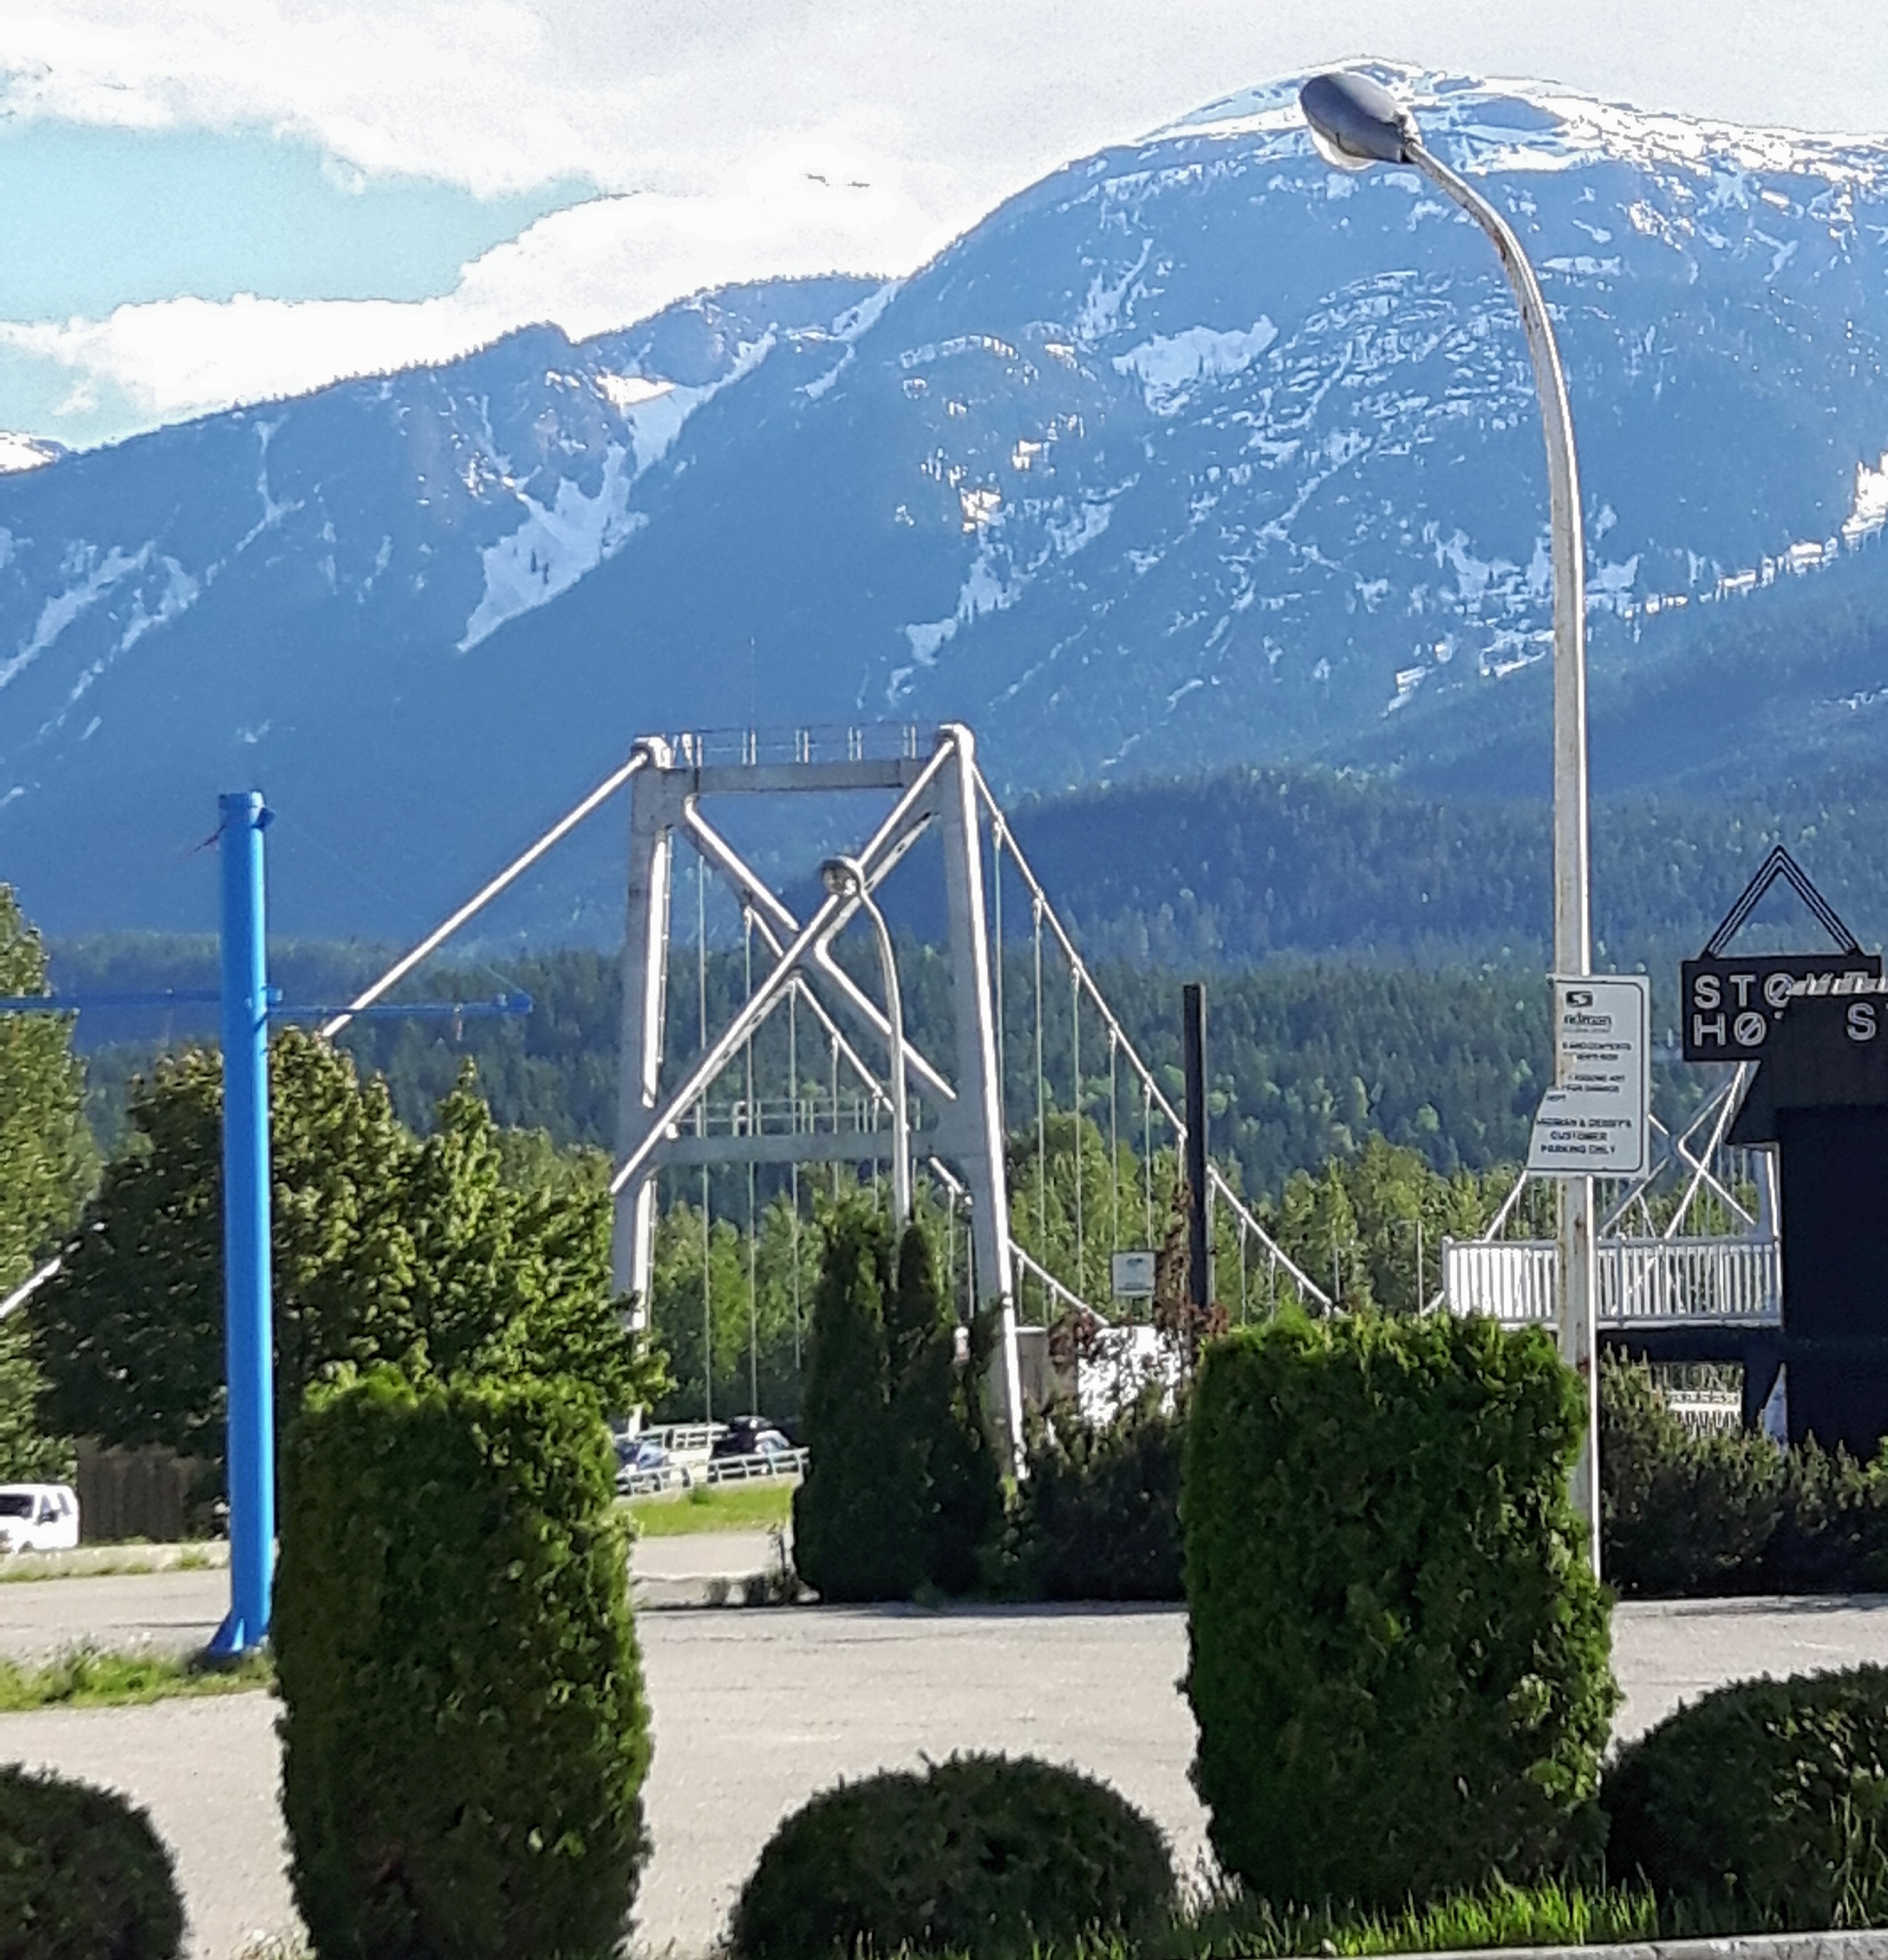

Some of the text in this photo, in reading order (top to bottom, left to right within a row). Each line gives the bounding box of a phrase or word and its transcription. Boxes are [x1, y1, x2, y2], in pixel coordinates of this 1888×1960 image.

[1550, 1130, 1608, 1141] CUSTOMER
[1541, 1144, 1615, 1155] PARKING ONLY
